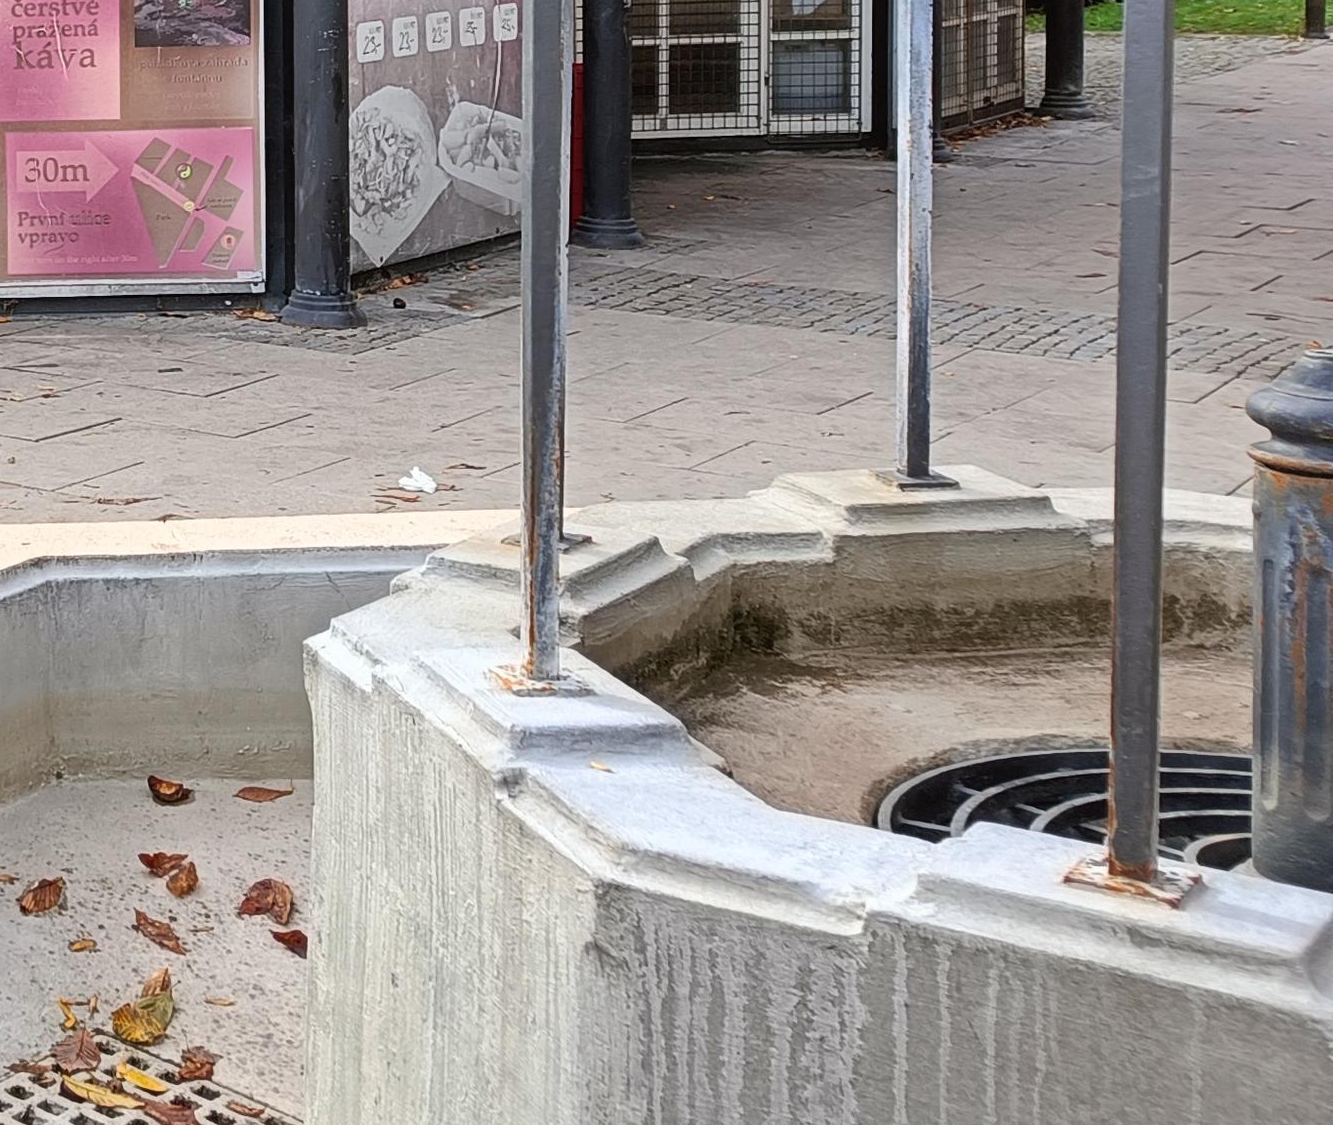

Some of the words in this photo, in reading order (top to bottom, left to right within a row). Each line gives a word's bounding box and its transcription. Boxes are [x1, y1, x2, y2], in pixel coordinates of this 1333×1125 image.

[13, 19, 99, 44] pražená
[13, 41, 97, 70] káva
[24, 157, 90, 183] 30m
[18, 231, 80, 249] vpravo
